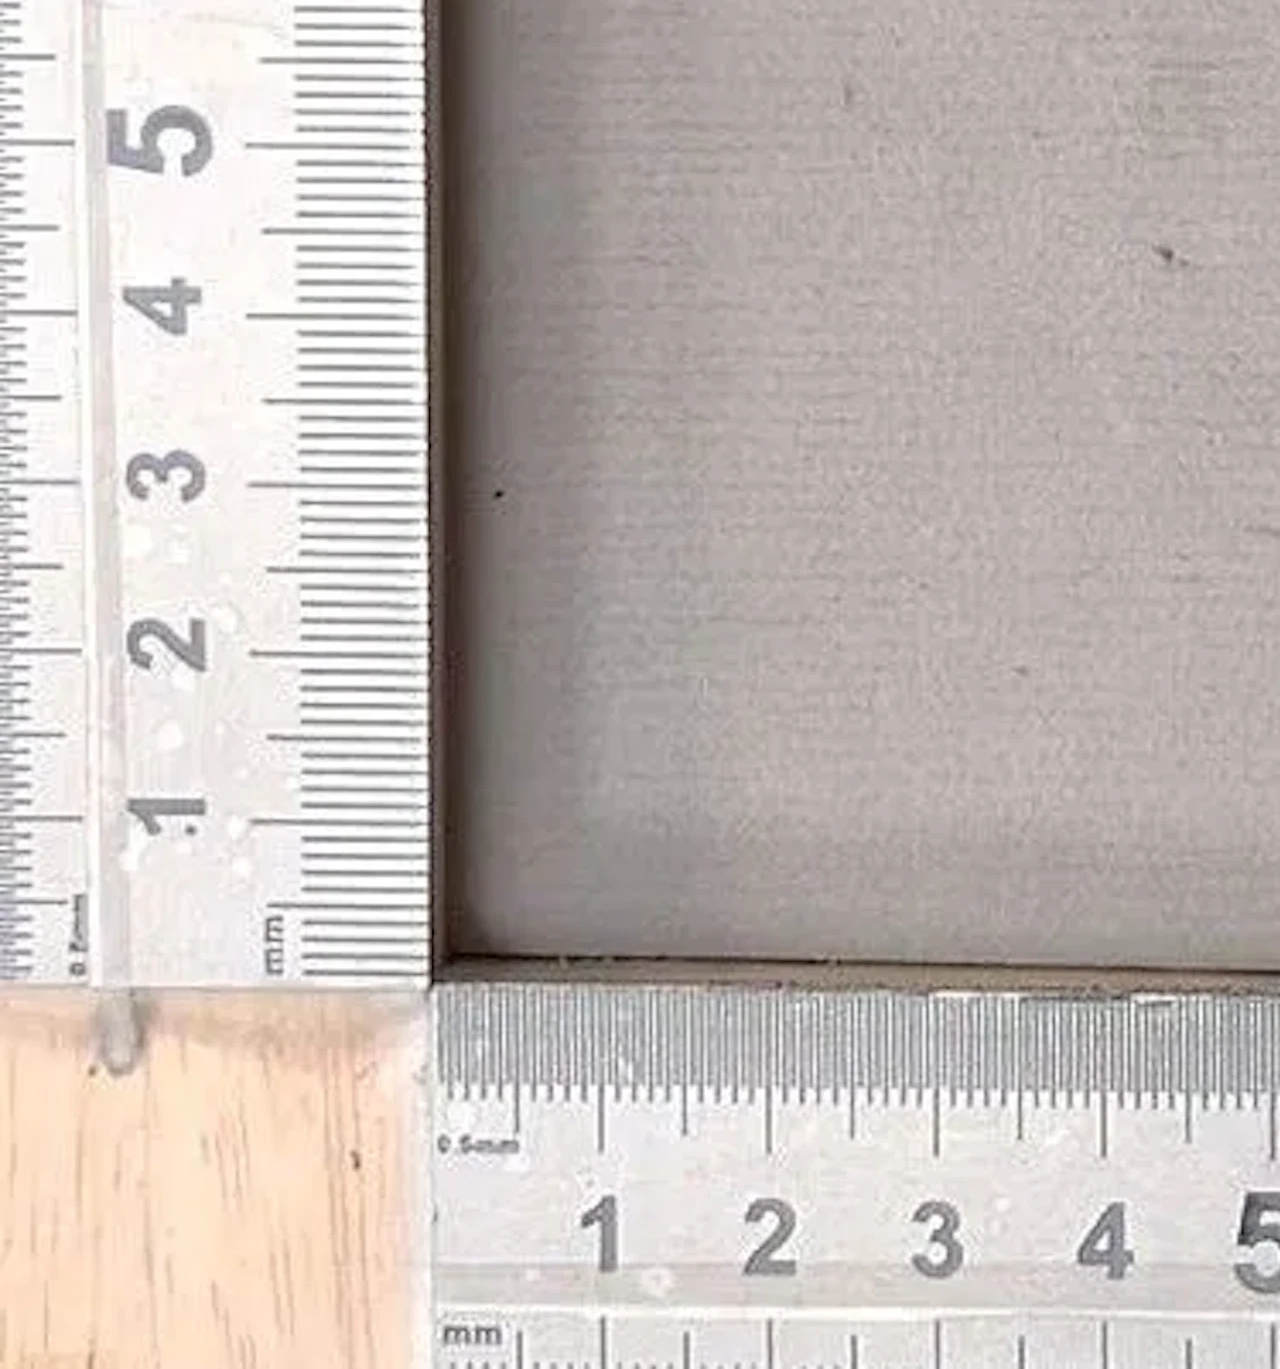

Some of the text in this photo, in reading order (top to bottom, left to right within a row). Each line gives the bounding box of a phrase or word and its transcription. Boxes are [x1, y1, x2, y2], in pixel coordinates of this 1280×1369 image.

[106, 106, 212, 176] 5
[123, 278, 201, 335] 4
[126, 450, 205, 503] 3
[127, 619, 206, 672] 2
[127, 799, 206, 835] 1
[581, 1196, 617, 1273] 1
[743, 1199, 796, 1276] 2
[912, 1202, 963, 1279] 3
[1077, 1203, 1134, 1279] 4
[442, 1325, 502, 1346] mm
